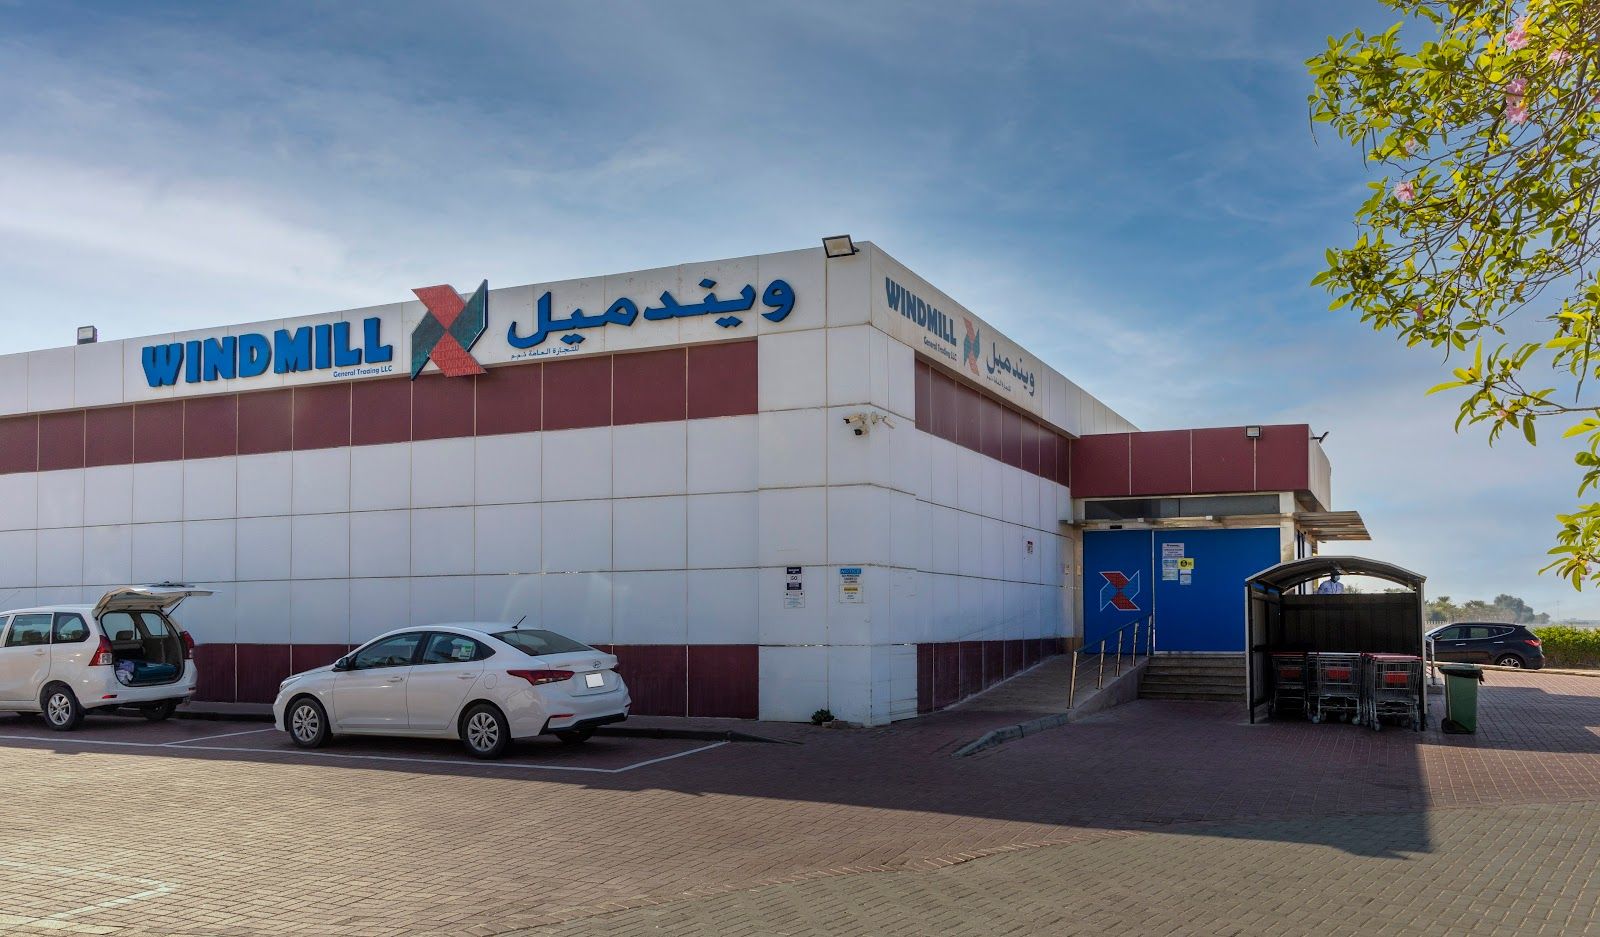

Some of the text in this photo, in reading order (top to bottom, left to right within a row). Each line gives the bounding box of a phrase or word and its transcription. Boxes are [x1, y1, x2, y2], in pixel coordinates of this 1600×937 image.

[507, 278, 796, 349] ويندميل
[886, 276, 957, 347] WINDMILL
[142, 317, 393, 388] WINDMILL
[333, 365, 393, 378] General Trading LLC
[529, 347, 551, 357] العامة
[986, 341, 1035, 397] ويندميل
